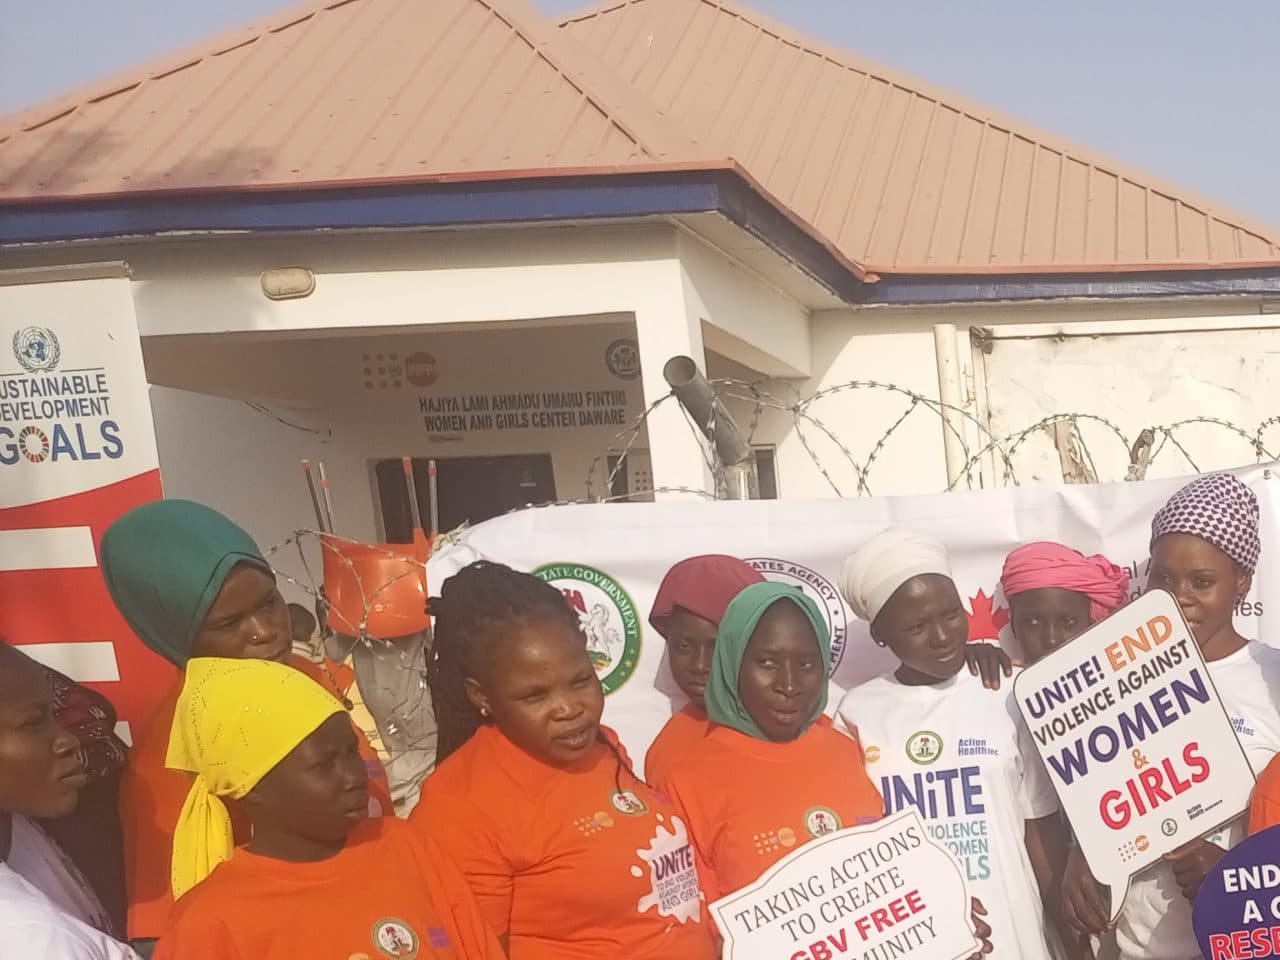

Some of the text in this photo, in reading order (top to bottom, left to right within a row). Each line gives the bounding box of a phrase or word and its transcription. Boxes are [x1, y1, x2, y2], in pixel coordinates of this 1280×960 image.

[0, 374, 109, 399] USTAINABLE
[0, 397, 110, 422] EVELOPMENT
[419, 397, 460, 414] HAJIYA
[462, 396, 490, 412] LAMI
[424, 408, 626, 432] WOMEN AND GIRLS CENTER DAWARE
[0, 420, 124, 465] GOALS
[752, 560, 836, 602] ATES AGENCY
[536, 566, 638, 638] TATE GOVERNMENT
[1104, 615, 1173, 672] END
[1033, 639, 1190, 746] VIOLENCE AGAINST
[959, 738, 987, 747] Action
[1047, 668, 1211, 786] WOMEN
[1131, 748, 1149, 769] &
[1099, 742, 1211, 830] GIRLS
[927, 820, 987, 839] IOLENCE
[944, 838, 989, 856] OMEN
[680, 884, 700, 902] GIRL
[734, 874, 825, 933] TAKING
[829, 825, 922, 890] ACTIONS
[781, 866, 905, 942] TO CREATE
[854, 889, 927, 941] FREE
[1243, 899, 1263, 924] A
